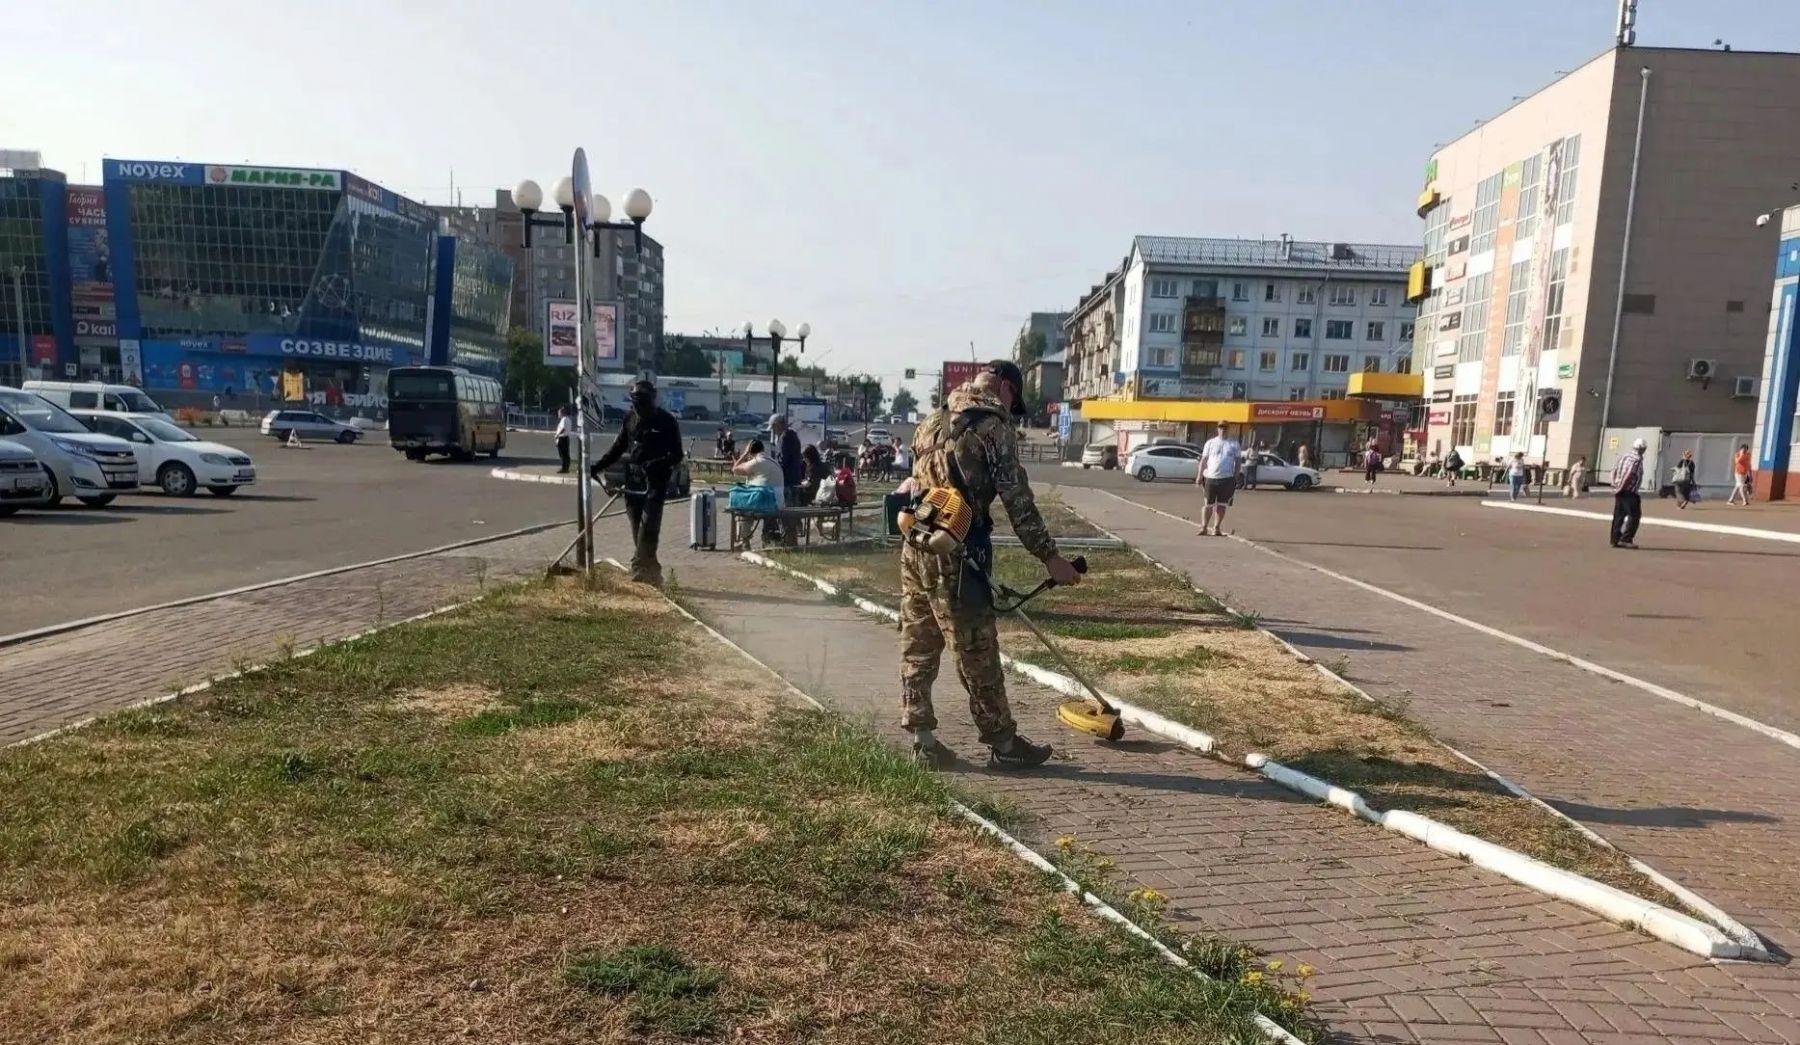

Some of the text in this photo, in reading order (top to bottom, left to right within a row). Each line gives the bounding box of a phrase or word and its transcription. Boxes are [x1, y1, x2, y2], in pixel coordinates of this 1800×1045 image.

[231, 169, 335, 187] МАРИЯ-РА
[91, 324, 116, 336] kari
[281, 340, 393, 361] СОЗВЕЗДИЕ
[343, 392, 389, 408] БИЙС
